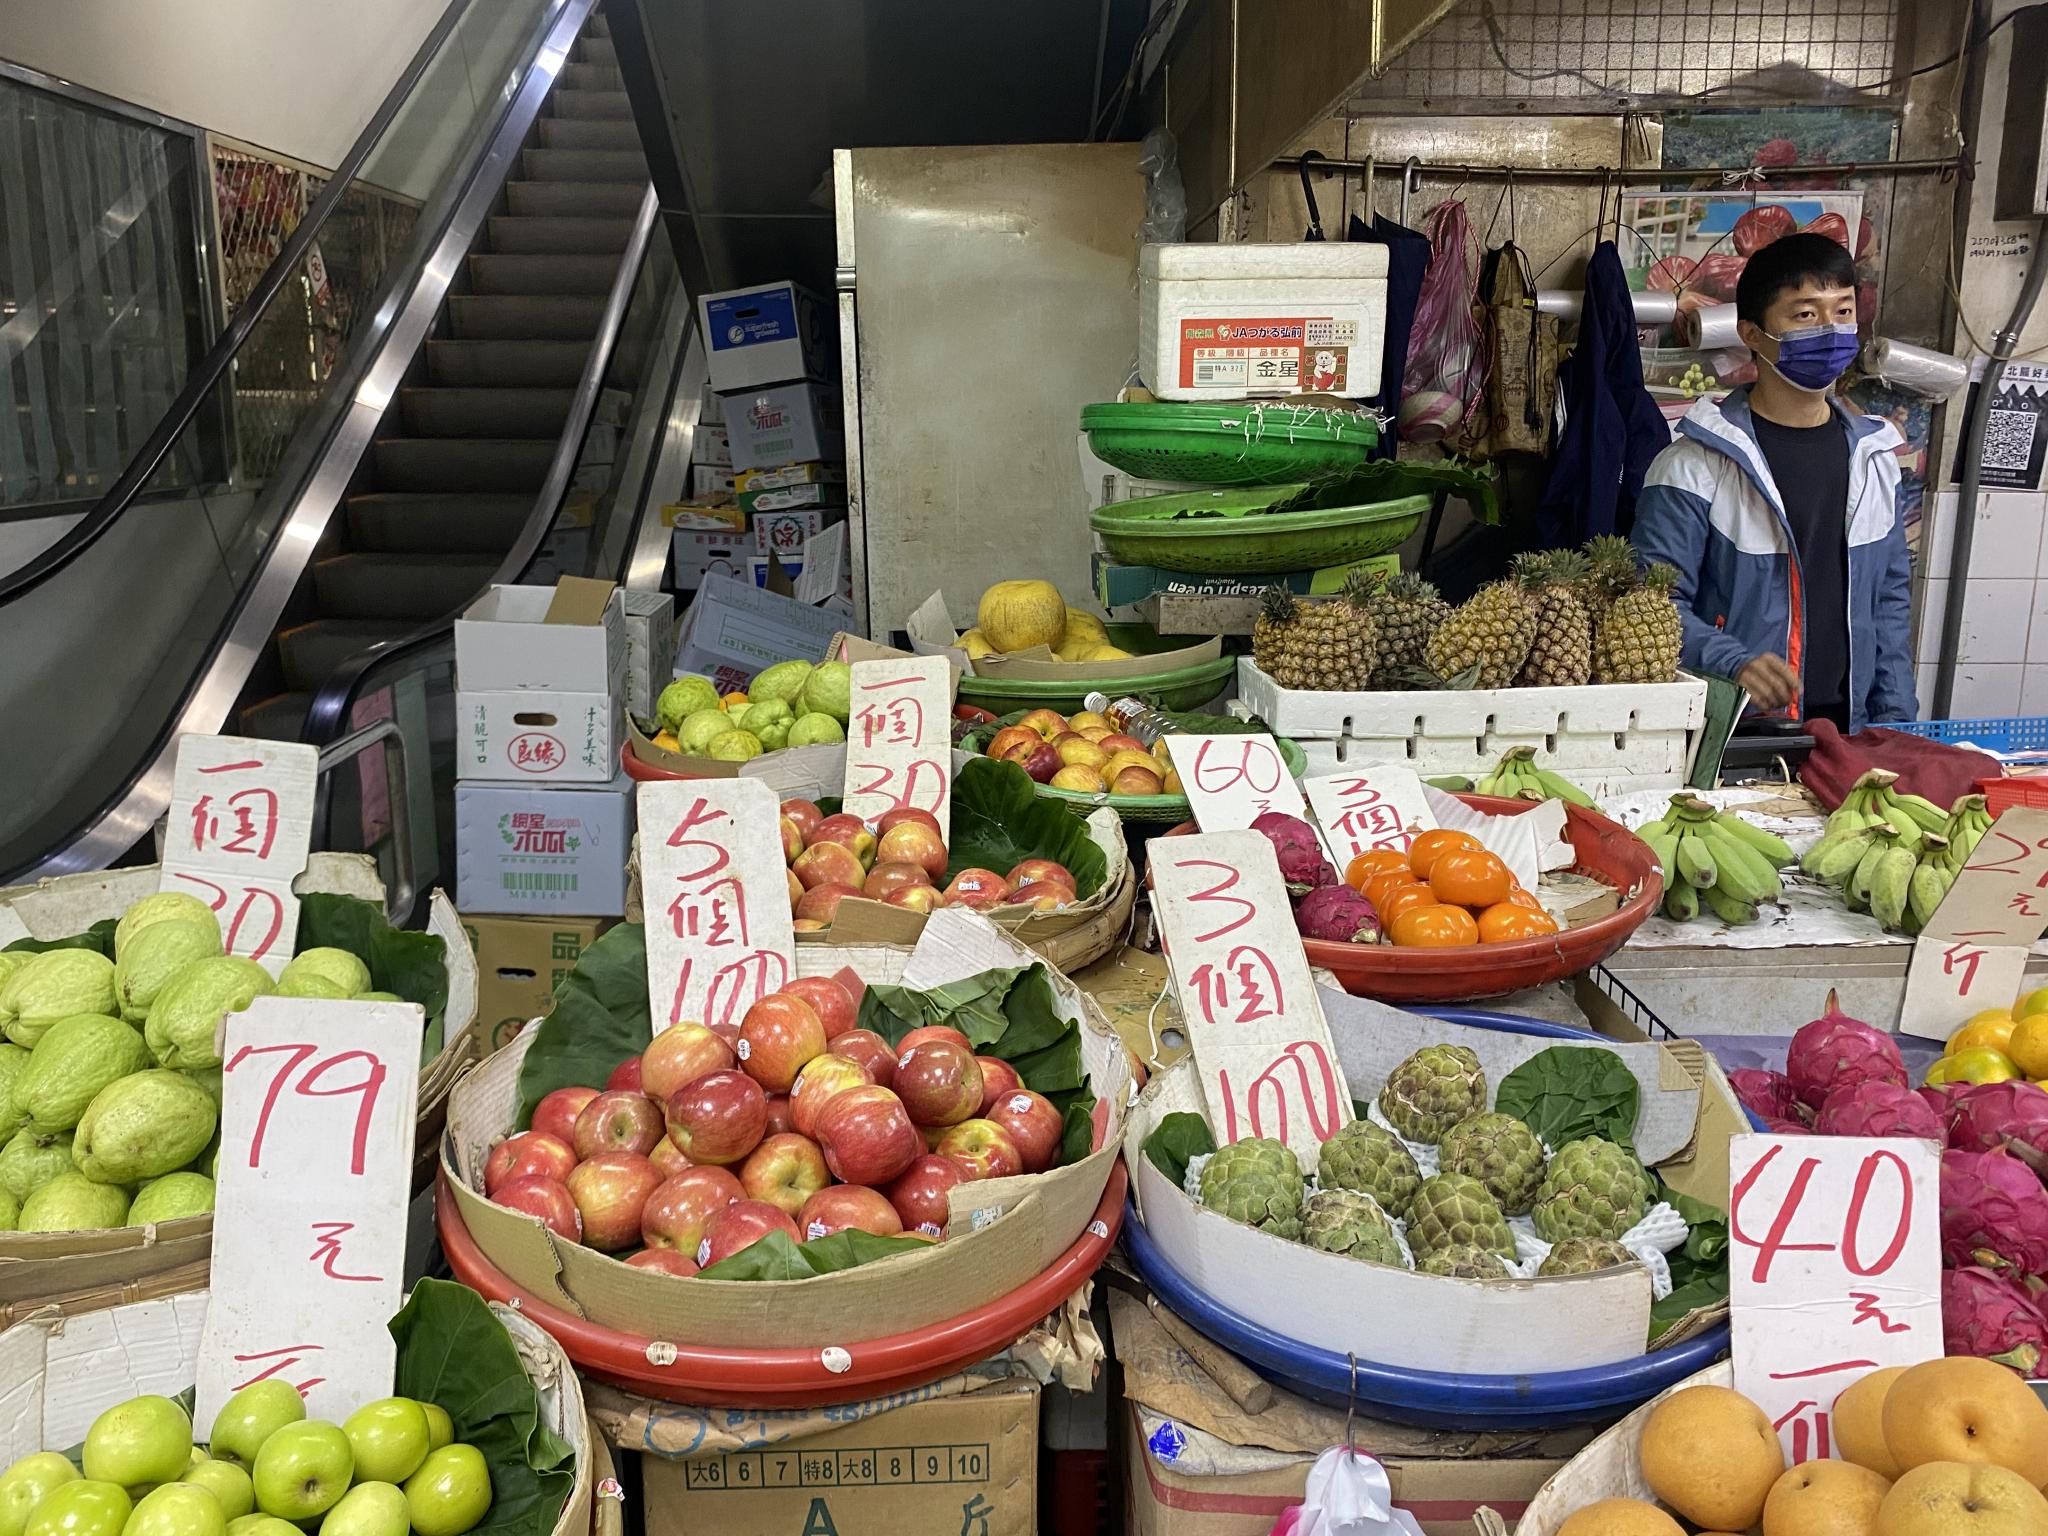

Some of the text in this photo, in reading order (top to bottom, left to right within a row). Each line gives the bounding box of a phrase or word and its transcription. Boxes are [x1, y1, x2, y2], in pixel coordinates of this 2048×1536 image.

[1232, 326, 1302, 338] JAつがる弘前
[1256, 360, 1298, 378] 金星
[1259, 348, 1289, 357] 品種名
[1194, 740, 1281, 793] 60
[853, 759, 947, 823] 30
[513, 829, 566, 853] 木瓜
[225, 1043, 388, 1176] 79
[1219, 1040, 1341, 1145] 100
[1731, 1144, 1914, 1284] 40
[692, 1454, 981, 1483] 大6 6 7 特8 大8 8 9 10
[801, 1498, 839, 1536] A
